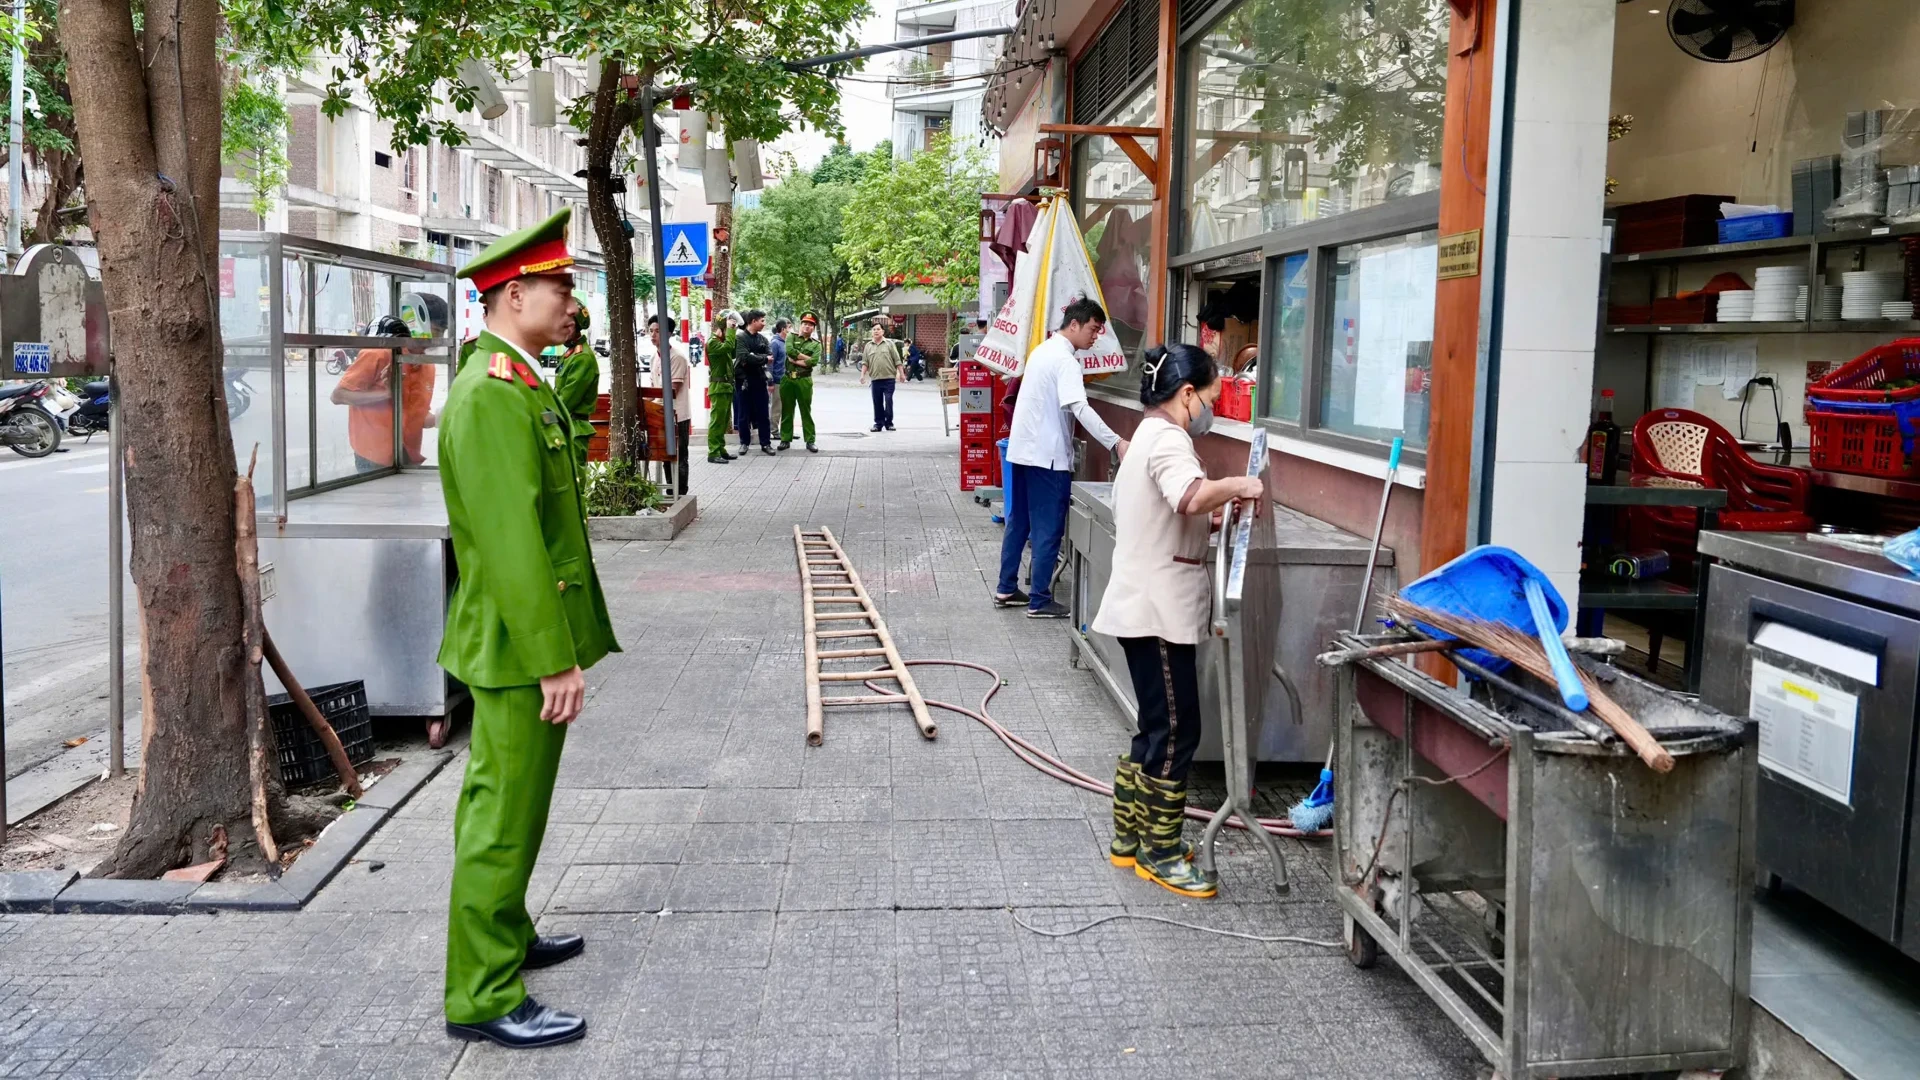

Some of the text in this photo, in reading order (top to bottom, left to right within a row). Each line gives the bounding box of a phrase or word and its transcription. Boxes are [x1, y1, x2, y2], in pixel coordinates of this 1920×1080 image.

[987, 349, 1002, 364] HÀ
[1001, 355, 1019, 372] NỘI
[1083, 352, 1124, 369] HÀ NỘI
